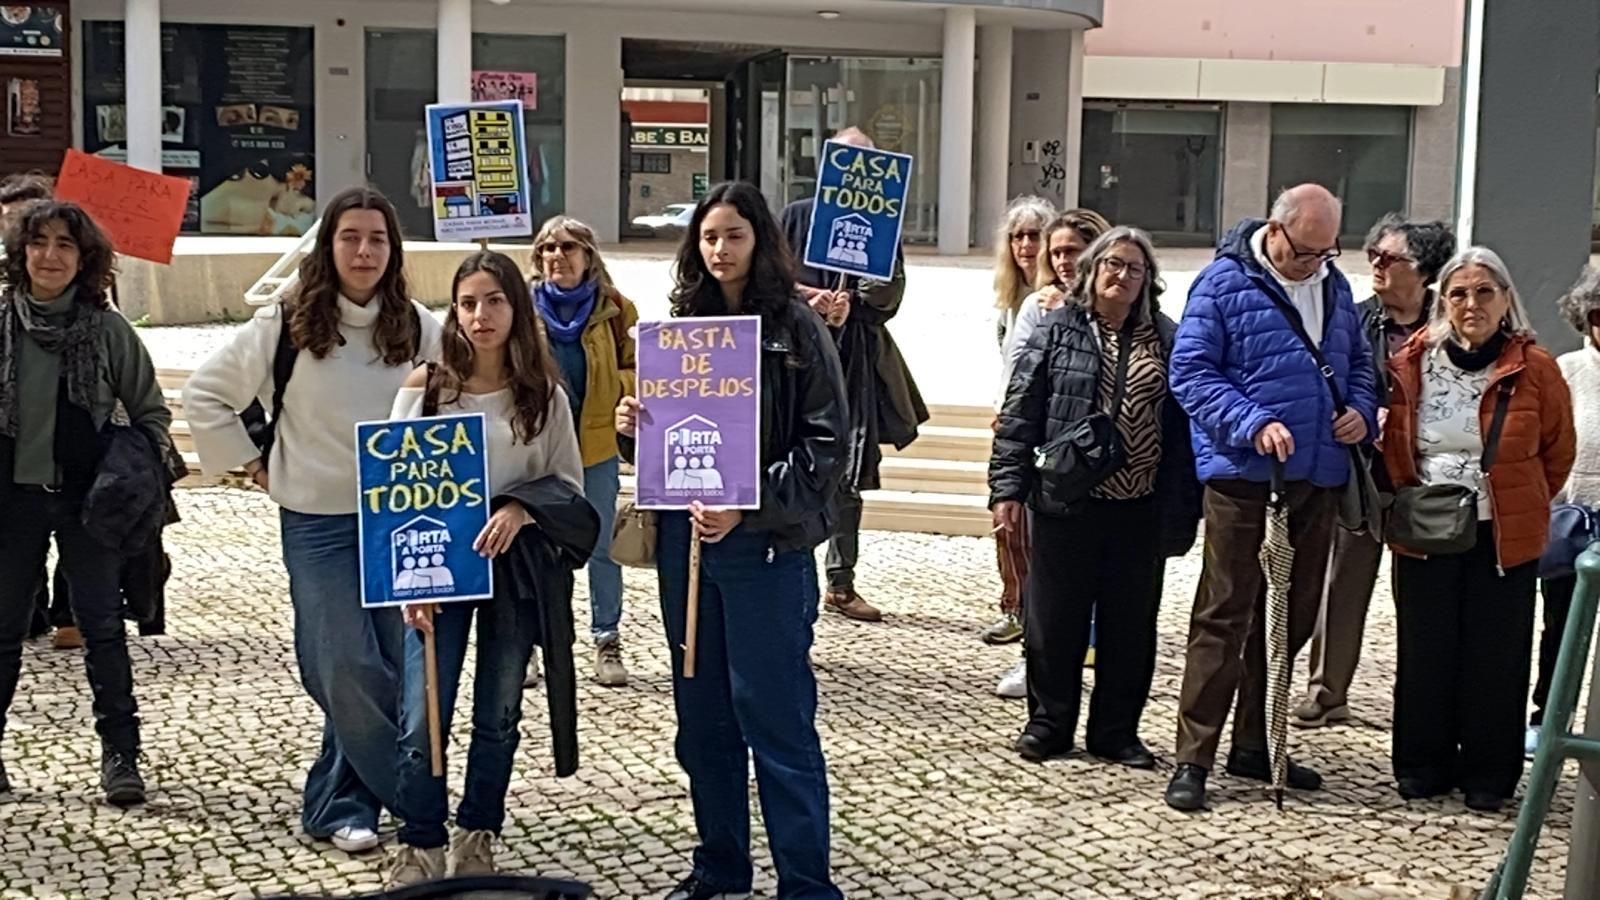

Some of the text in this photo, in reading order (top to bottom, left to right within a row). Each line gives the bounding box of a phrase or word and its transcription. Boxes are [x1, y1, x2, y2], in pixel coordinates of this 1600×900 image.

[67, 154, 172, 200] CASA PARA
[830, 148, 901, 183] CASA
[841, 173, 884, 195] PARA
[822, 186, 900, 218] TODOS
[658, 326, 737, 351] BASTA
[681, 353, 714, 375] DE
[641, 377, 754, 399] DESPEJOS
[366, 422, 476, 460] CASA
[683, 446, 717, 455] PORTA
[391, 459, 454, 482] PARA
[363, 478, 483, 514] TODOS
[411, 544, 446, 554] PORTA
